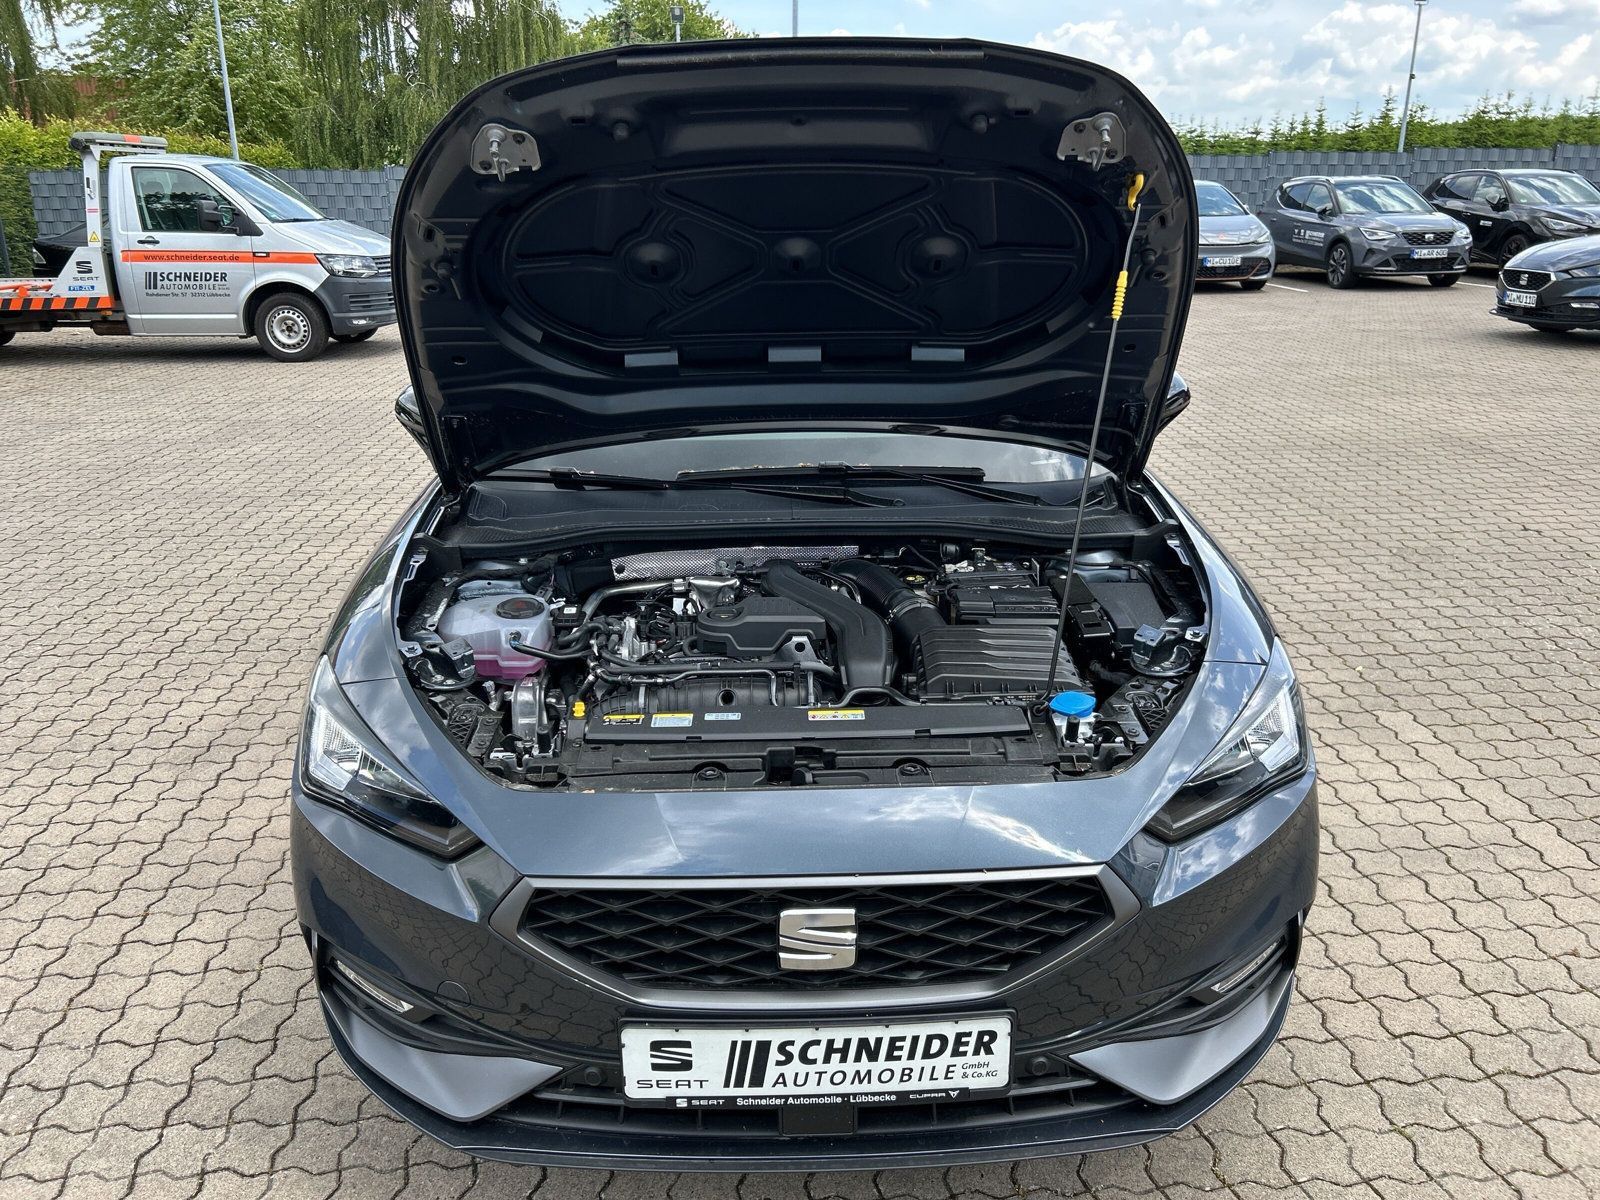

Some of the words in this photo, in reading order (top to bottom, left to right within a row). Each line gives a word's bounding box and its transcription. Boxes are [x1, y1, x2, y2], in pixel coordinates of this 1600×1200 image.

[159, 271, 228, 282] SCHNEIDER
[774, 1029, 998, 1067] SCHNEIDER
[961, 1061, 990, 1070] GmbH
[771, 1063, 957, 1088] AUTOMOBILE
[961, 1071, 969, 1079] &
[636, 1079, 709, 1089] SEAT
[736, 1096, 786, 1106] Schneider
[787, 1094, 842, 1104] Automobile
[850, 1093, 896, 1104] Lübbecke
